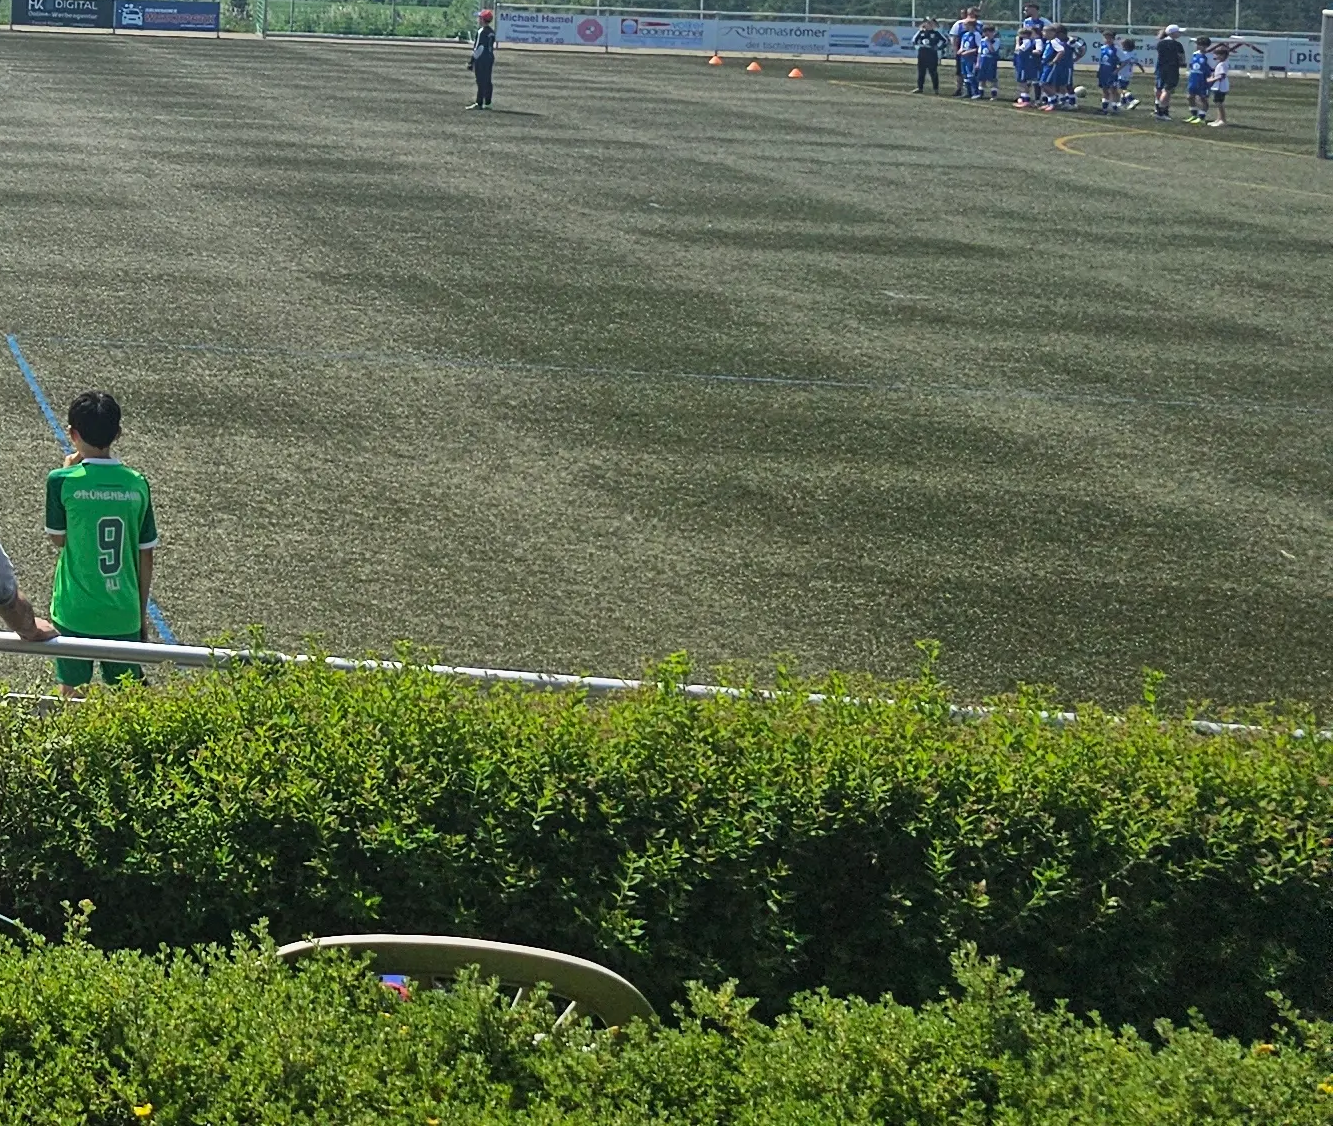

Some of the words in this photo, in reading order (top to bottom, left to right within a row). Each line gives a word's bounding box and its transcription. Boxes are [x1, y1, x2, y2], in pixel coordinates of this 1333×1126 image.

[55, 0, 98, 10] DIGITAL
[500, 13, 539, 23] Michael
[541, 14, 574, 24] Hamel
[96, 516, 125, 577] 9
[105, 577, 120, 591] ALI
